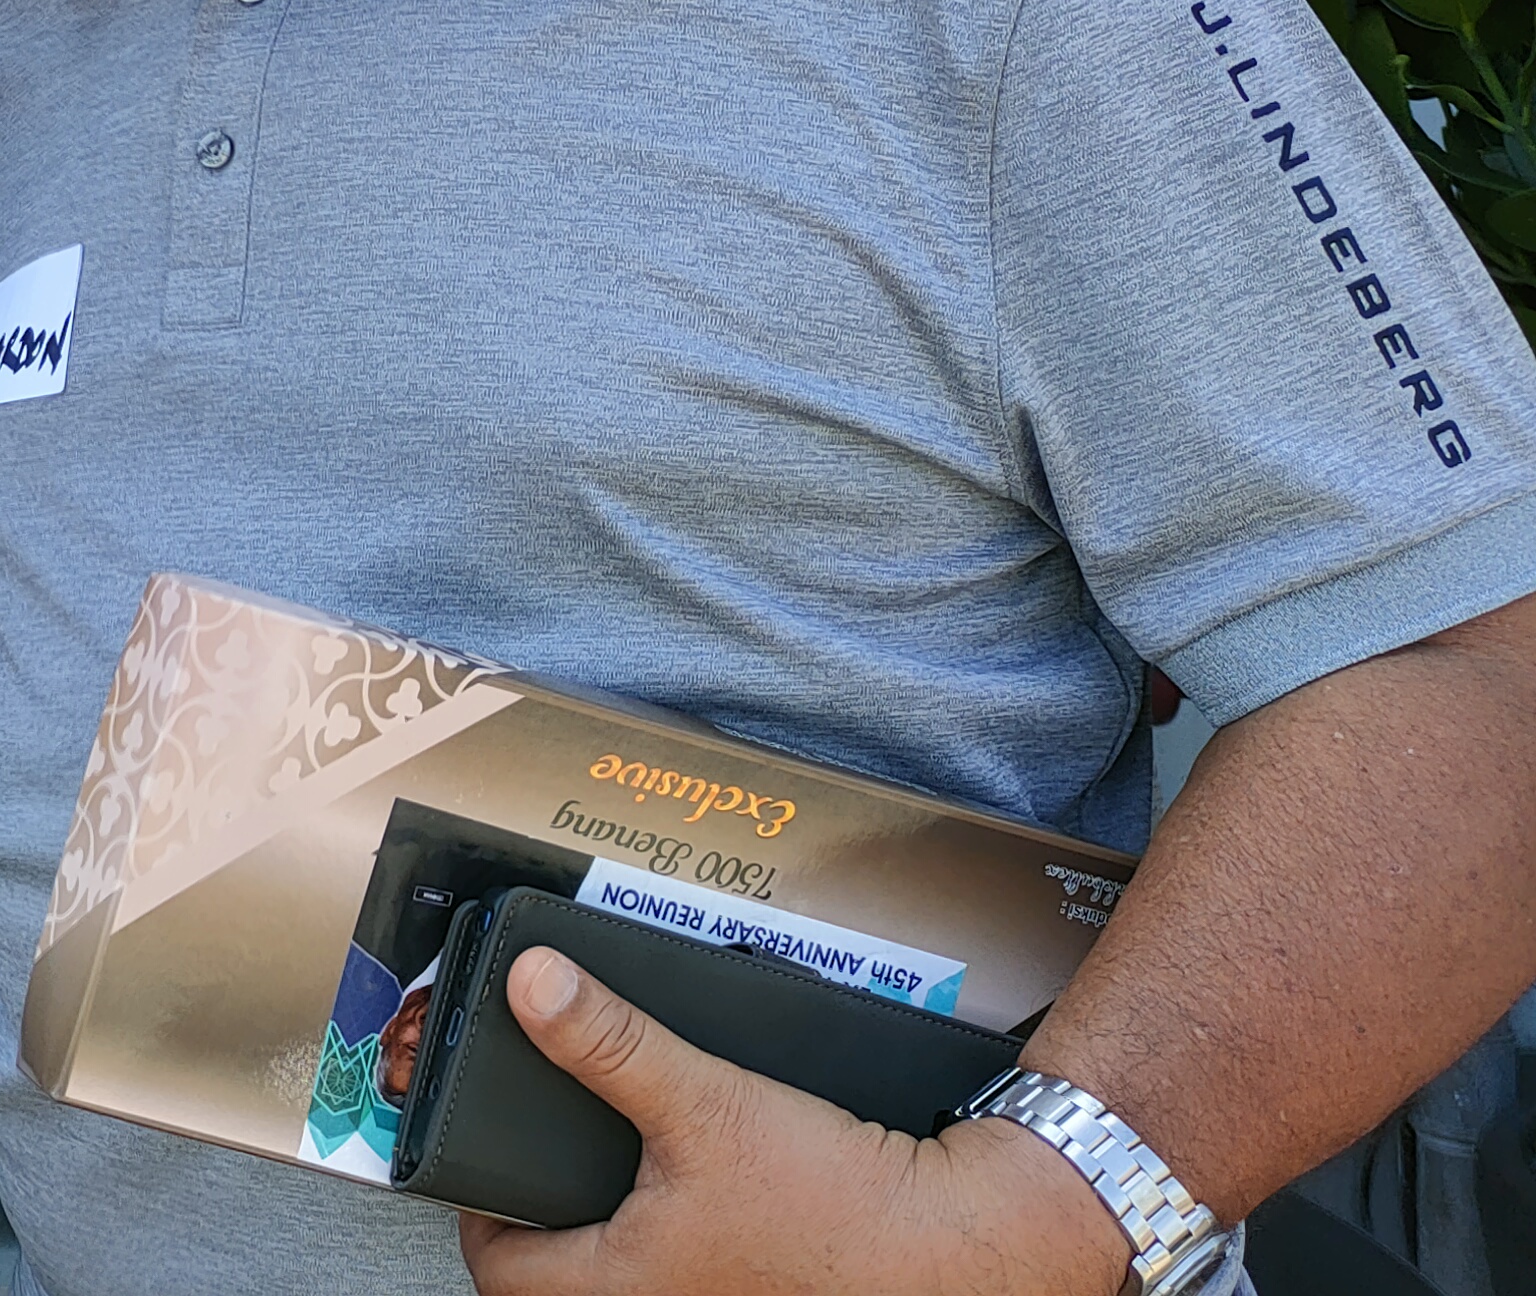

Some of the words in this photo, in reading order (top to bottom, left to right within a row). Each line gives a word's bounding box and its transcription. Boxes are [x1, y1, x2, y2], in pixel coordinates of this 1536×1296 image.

[1190, 1, 1473, 469] J.LINDEBERG
[589, 753, 797, 839] Exclusive
[549, 799, 694, 877] Benang
[601, 881, 706, 932] REUNION
[708, 914, 867, 977] ANNIVERSARY
[870, 959, 924, 994] 45th
